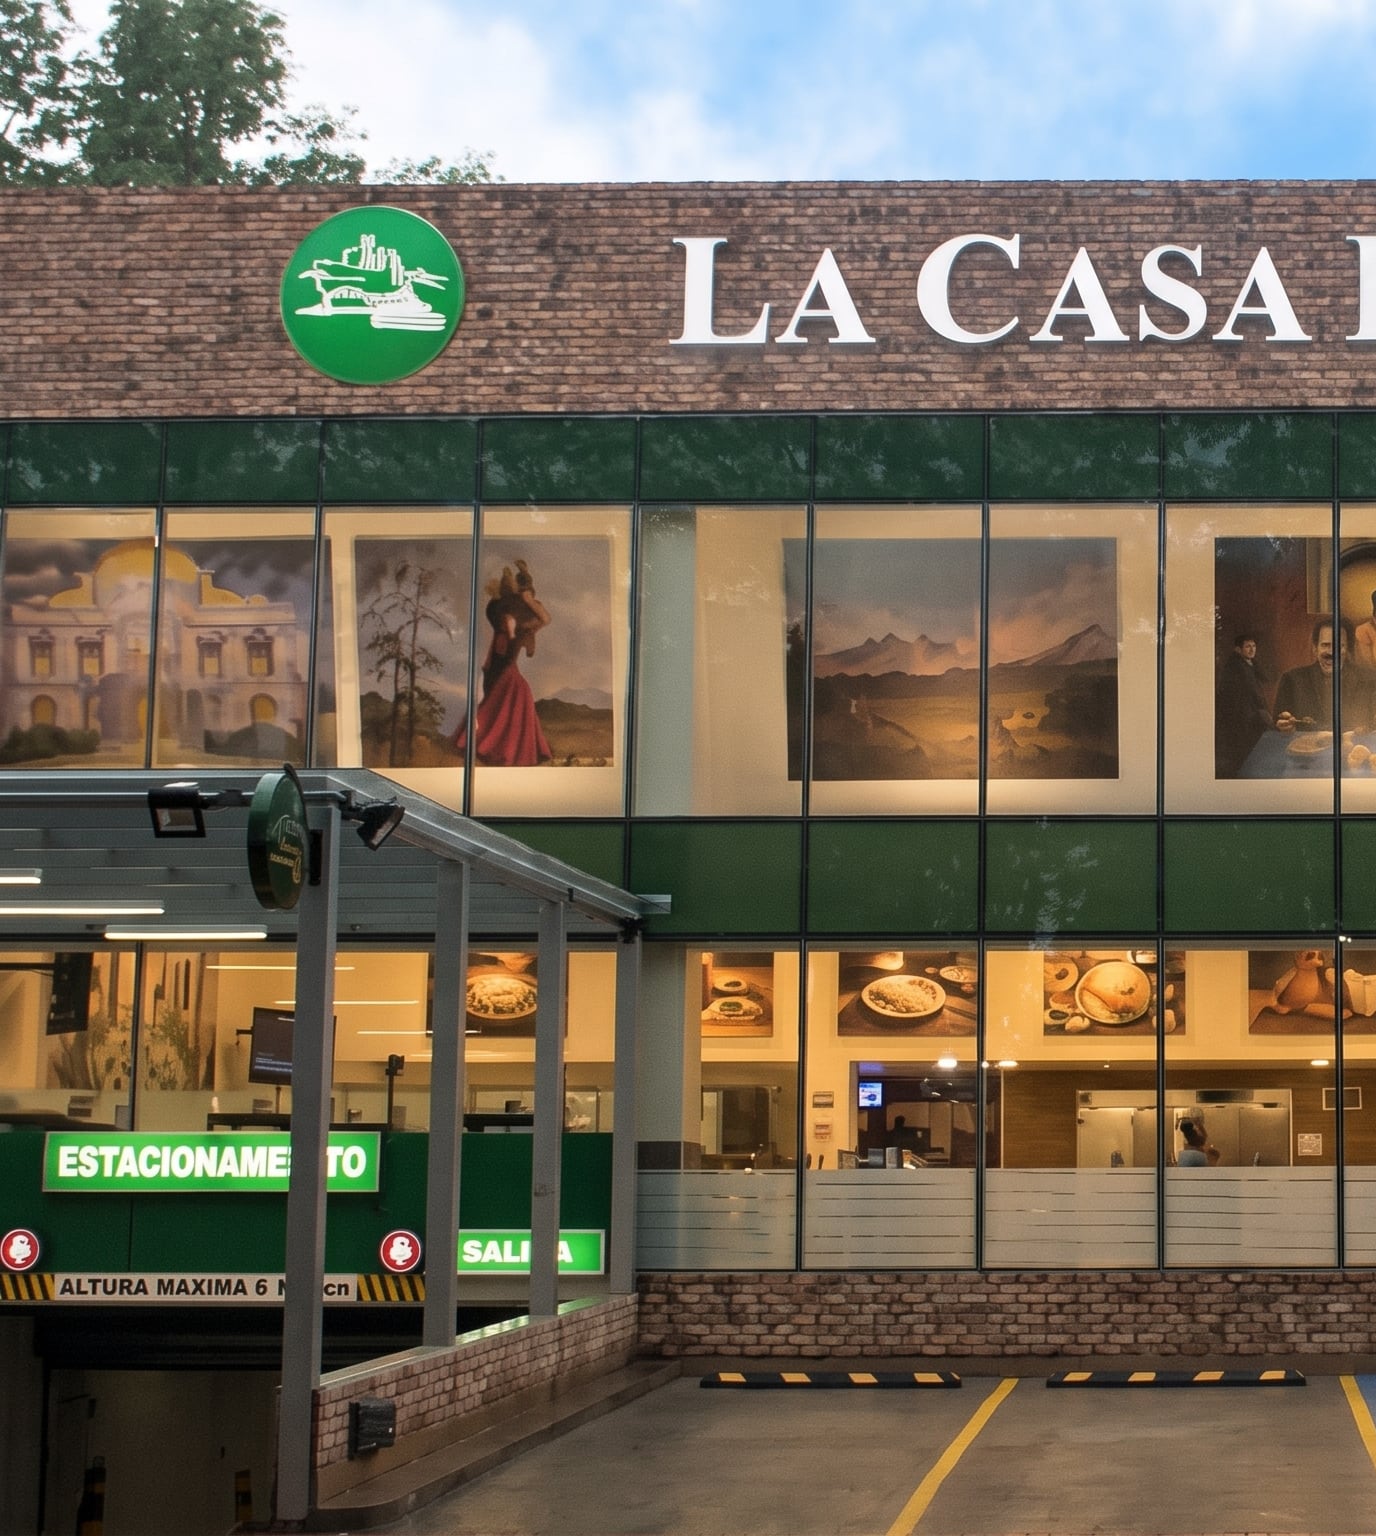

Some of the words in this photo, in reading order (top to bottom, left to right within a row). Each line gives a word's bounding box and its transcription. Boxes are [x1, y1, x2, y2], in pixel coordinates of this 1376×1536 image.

[669, 237, 876, 345] LA
[916, 233, 1313, 344] CASA
[57, 1145, 367, 1179] ESTACIONAMETO
[462, 1239, 574, 1263] SALIA
[59, 1278, 150, 1296] ALTURA
[156, 1278, 249, 1296] MAXIMA
